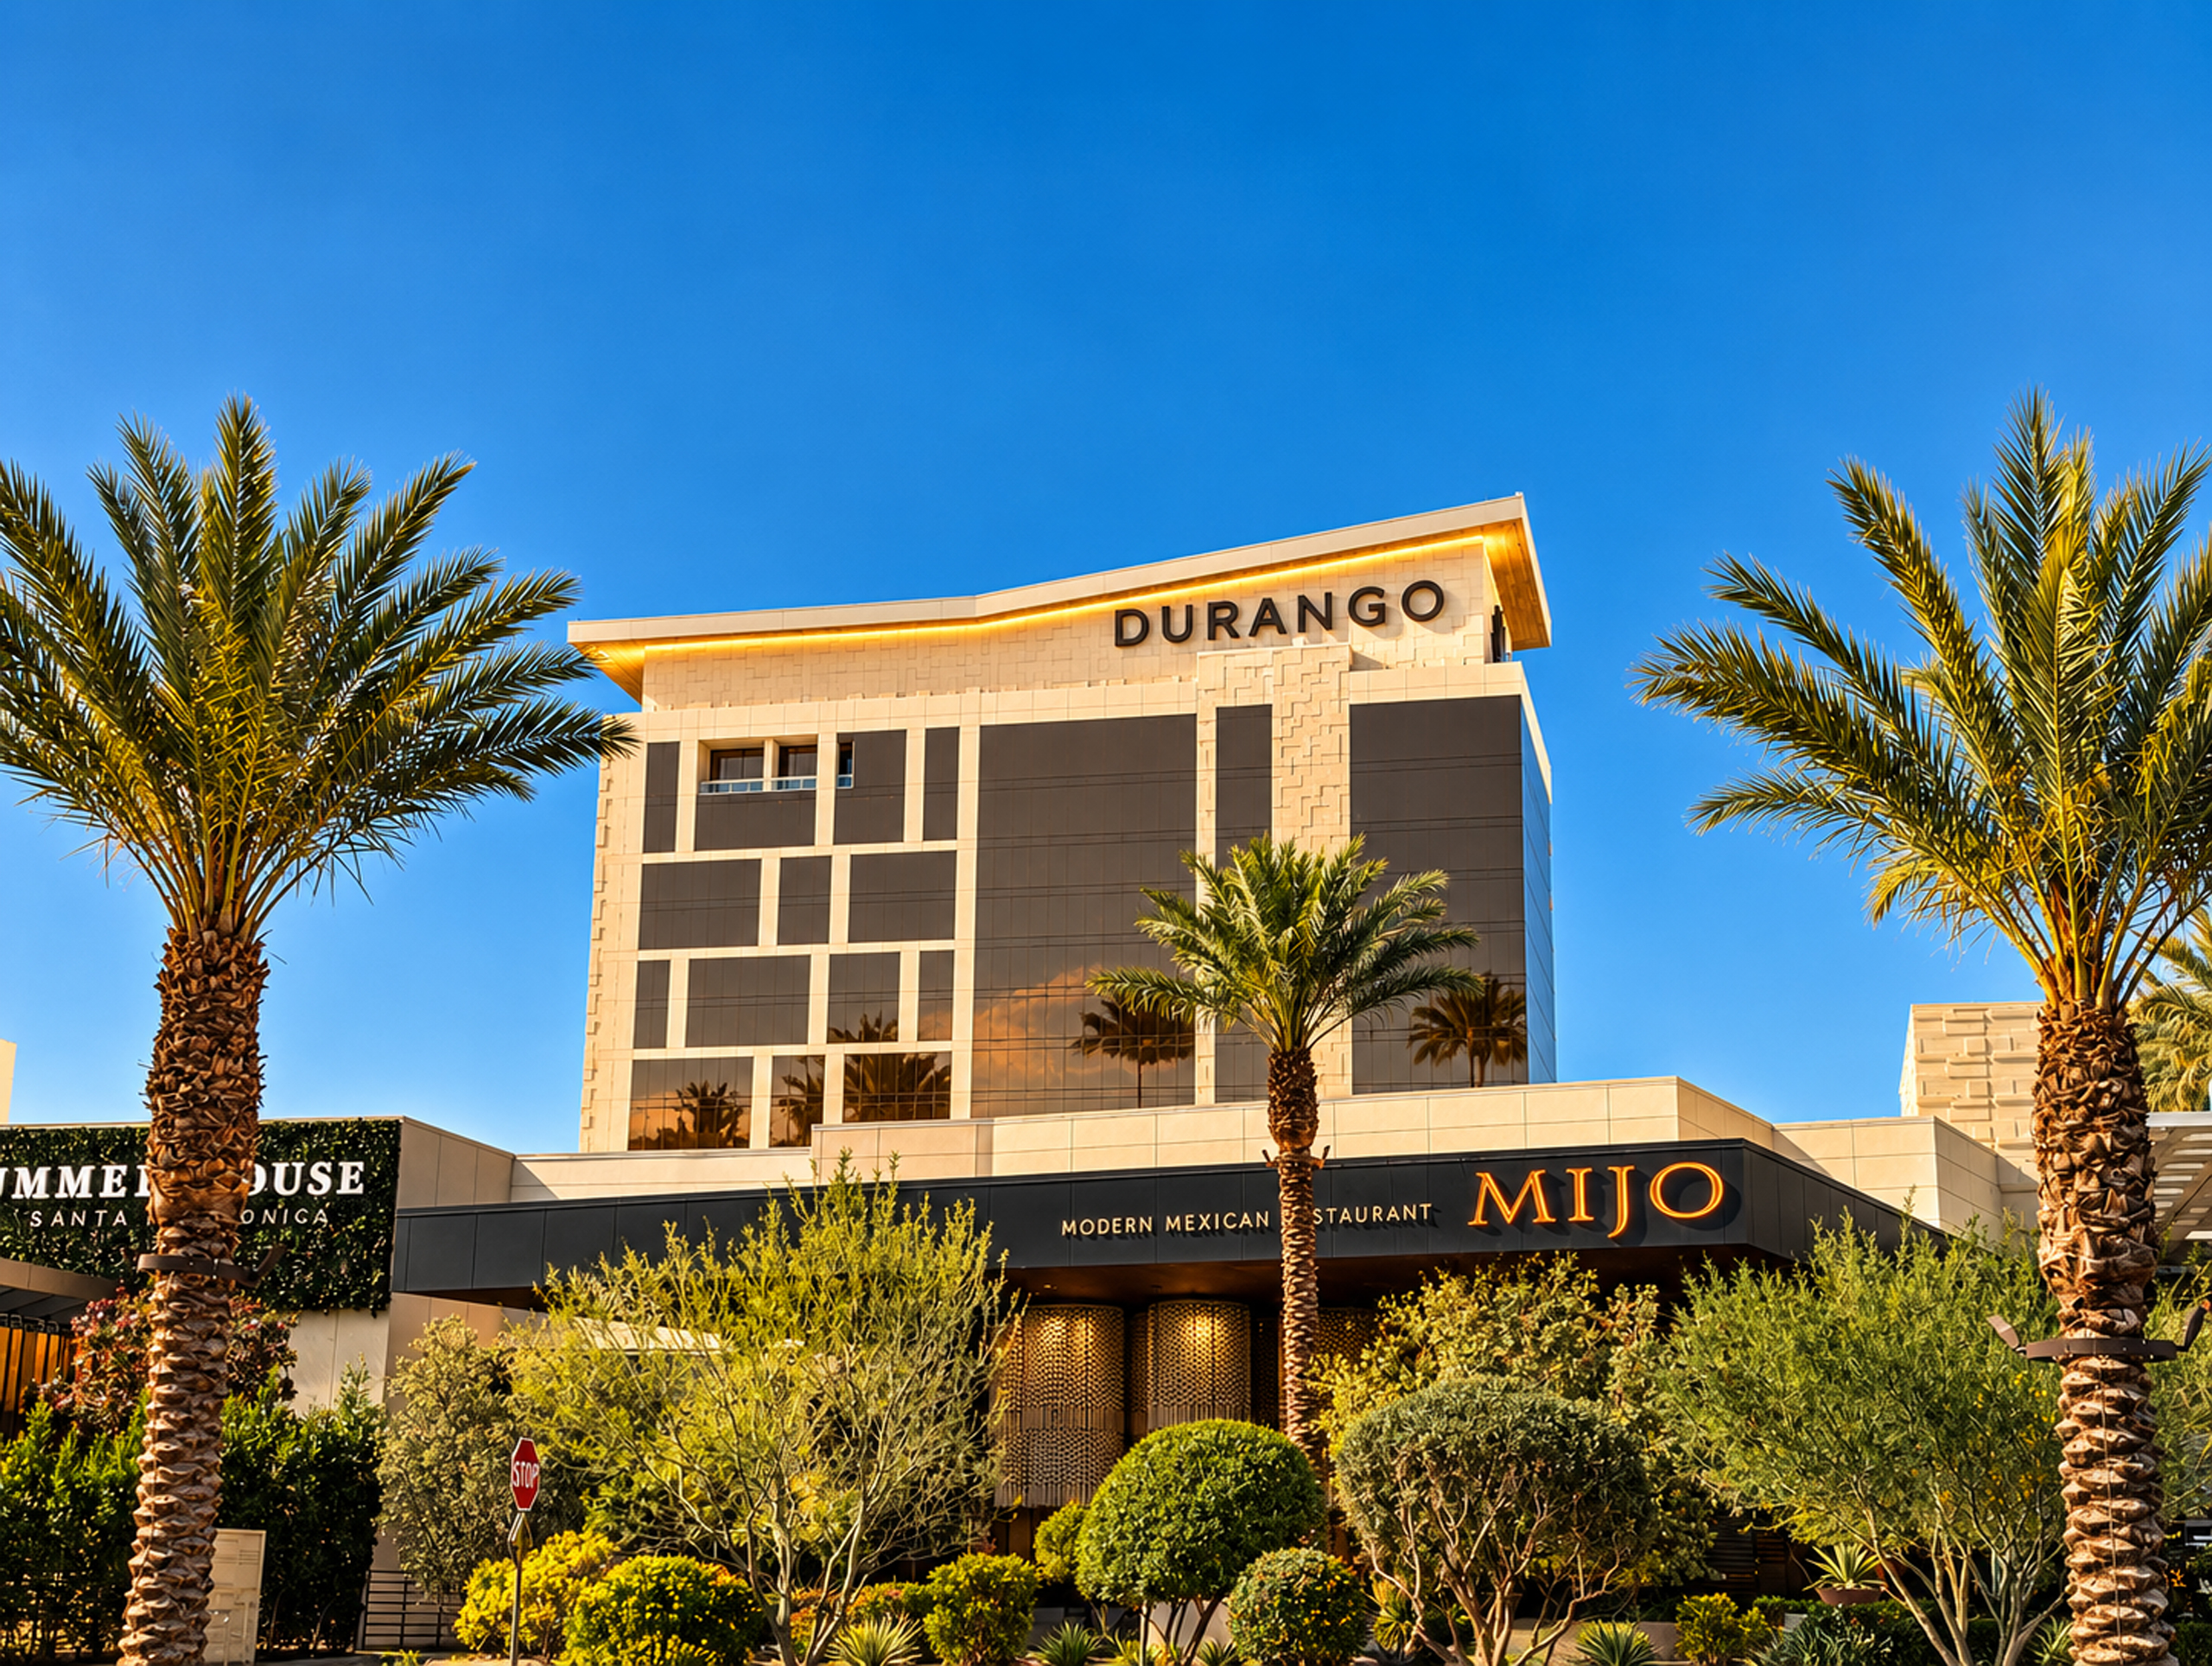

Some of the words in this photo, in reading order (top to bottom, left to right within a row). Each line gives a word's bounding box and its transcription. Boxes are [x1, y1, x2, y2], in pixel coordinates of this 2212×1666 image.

[1115, 580, 1445, 647] DURANGO
[0, 1164, 150, 1199] MME
[1467, 1161, 1724, 1238] MIJO
[29, 1210, 128, 1228] SANTA
[239, 1208, 328, 1225] ONICA
[1061, 1216, 1153, 1237] MODERN
[1166, 1211, 1269, 1232] MEXICAN
[1313, 1203, 1433, 1224] STAURANT
[512, 1460, 540, 1489] STOP
